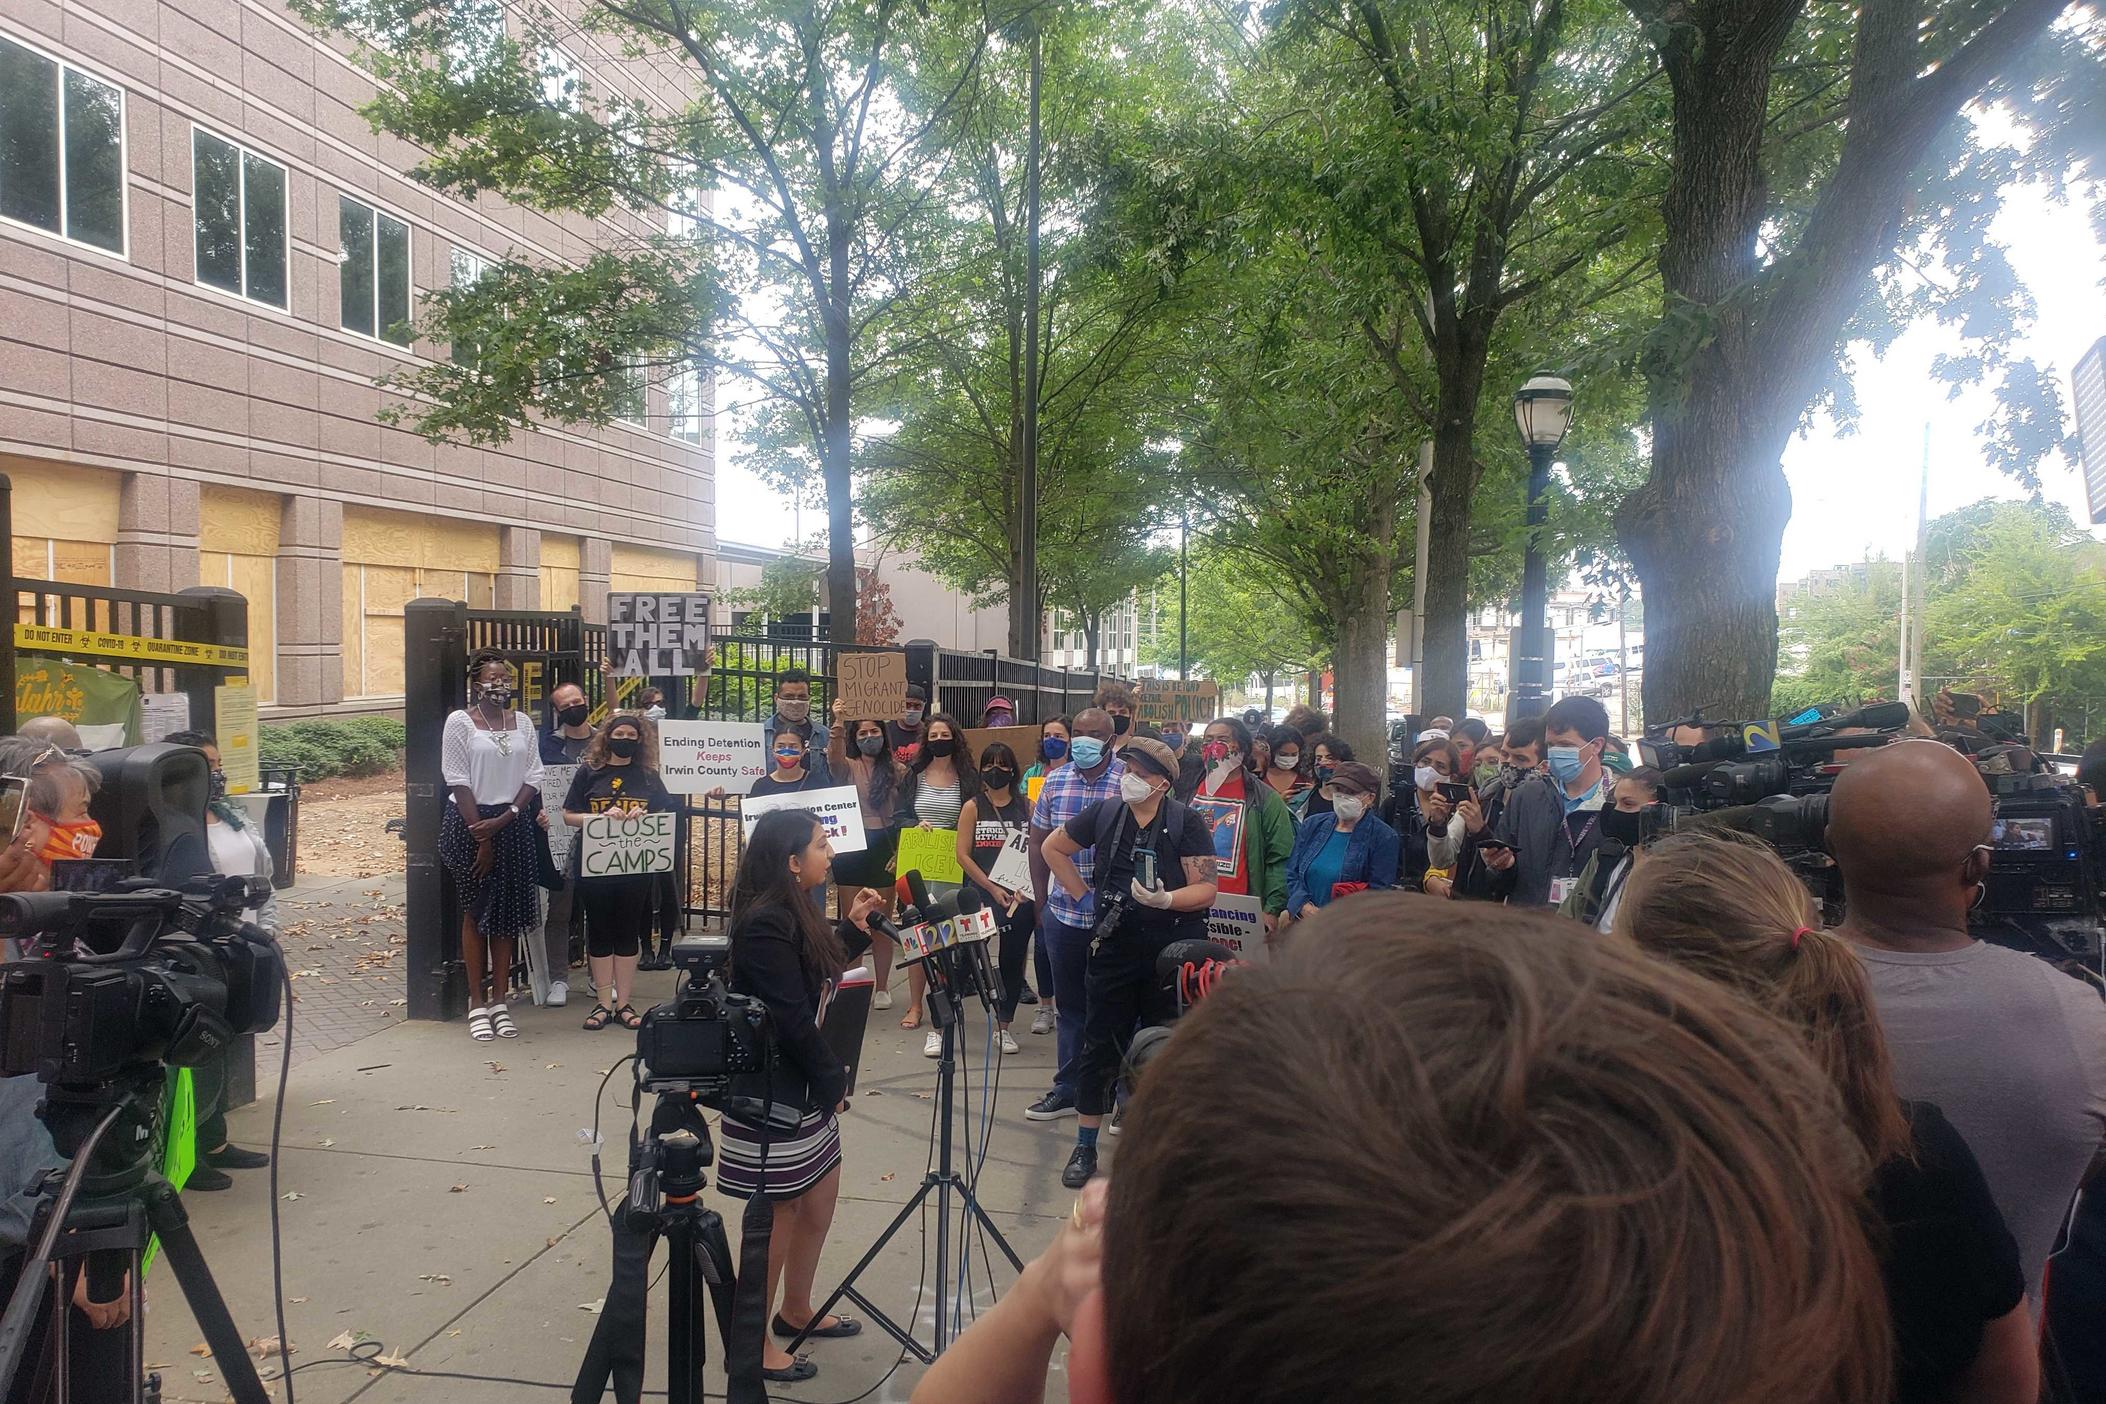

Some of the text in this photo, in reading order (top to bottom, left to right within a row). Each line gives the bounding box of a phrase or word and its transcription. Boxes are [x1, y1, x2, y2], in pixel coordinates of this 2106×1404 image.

[611, 596, 708, 622] FREE
[24, 629, 34, 640] DO
[36, 630, 50, 642] NOT
[51, 633, 73, 645] ENTER
[97, 637, 124, 650] COVID-19
[146, 641, 183, 655] QUARANTINE
[184, 645, 200, 656] ZONE
[611, 623, 706, 650] THEM
[622, 648, 695, 677] ALL
[843, 655, 891, 680] STOP
[844, 681, 905, 698] MIGRANT
[843, 699, 906, 717] GENOCIDE
[663, 736, 761, 749] Ending Detention
[696, 751, 732, 763] Keeps
[665, 765, 765, 777] Irwin County Safe
[824, 801, 857, 812] Center
[586, 815, 671, 840] CLOSE
[820, 814, 838, 825] ng
[619, 836, 642, 849] the
[1008, 833, 1030, 854] AB
[586, 847, 672, 874] CAMPS
[1208, 922, 1242, 936] sible
[199, 1030, 221, 1049] SONY
